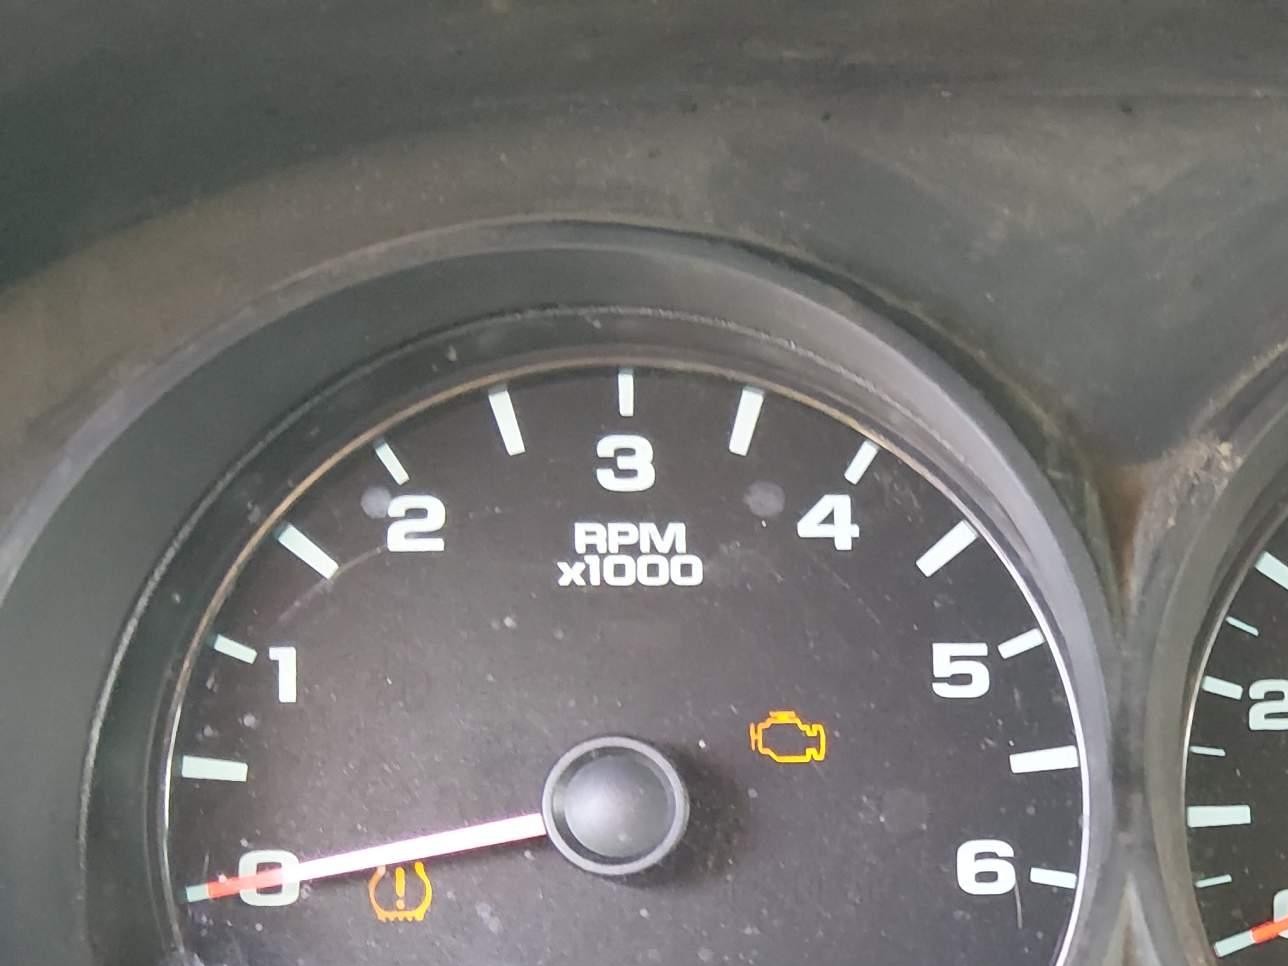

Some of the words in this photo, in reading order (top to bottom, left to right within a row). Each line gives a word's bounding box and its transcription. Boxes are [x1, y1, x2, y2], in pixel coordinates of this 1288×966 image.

[596, 435, 656, 491] 3
[386, 494, 445, 552] 2
[573, 521, 687, 555] RPM
[797, 494, 859, 550] 4
[556, 555, 705, 589] x1000
[268, 646, 297, 703] 1
[931, 643, 992, 699] 5
[239, 850, 300, 906] 0
[955, 839, 1016, 895] 6
